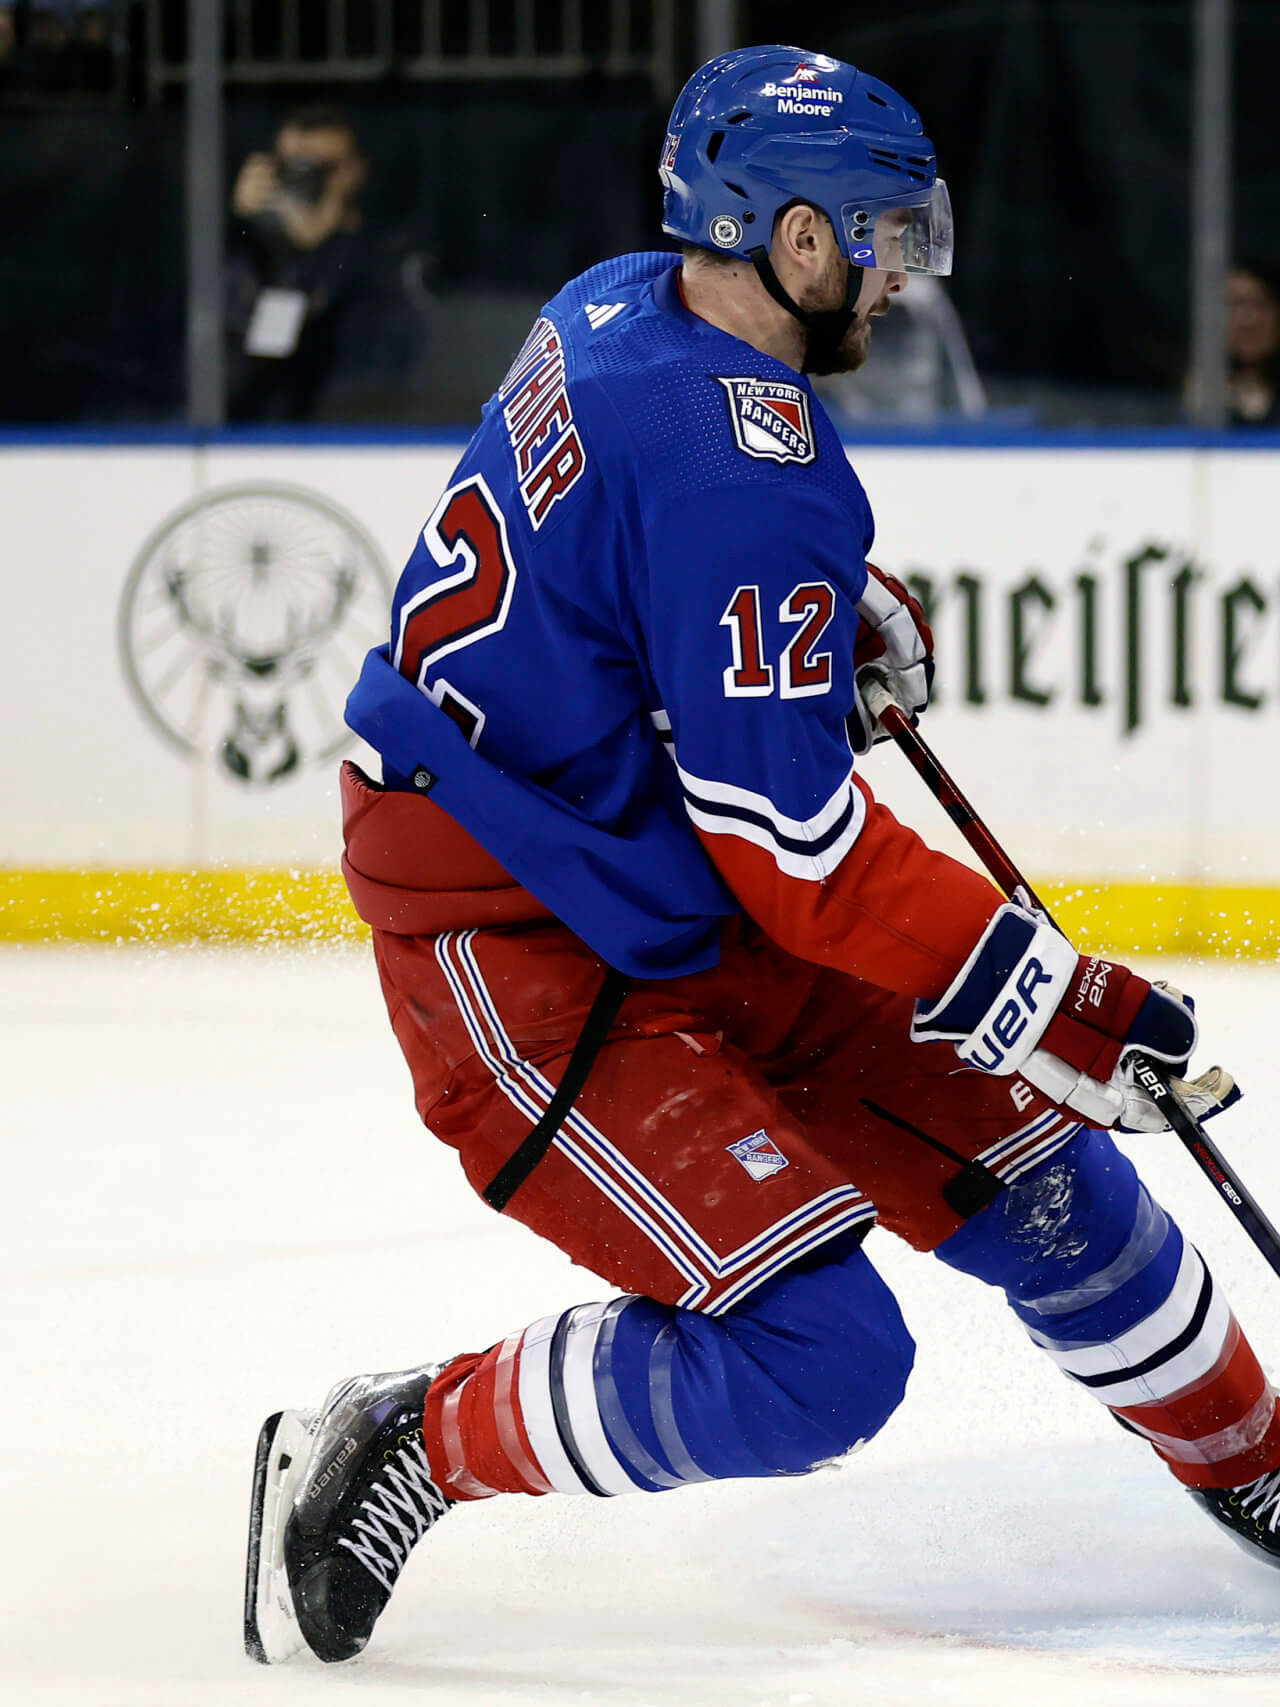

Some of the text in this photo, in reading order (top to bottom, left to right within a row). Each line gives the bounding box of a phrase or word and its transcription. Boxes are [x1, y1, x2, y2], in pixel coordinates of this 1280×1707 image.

[764, 82, 844, 103] Benjamin
[777, 99, 832, 117] Moore
[736, 383, 801, 402] NEW YORK
[740, 398, 807, 457] RANGERS
[719, 581, 836, 700] 12
[971, 957, 1053, 1071] UER
[1134, 1059, 1168, 1100] UER
[1221, 1181, 1243, 1206] GEO
